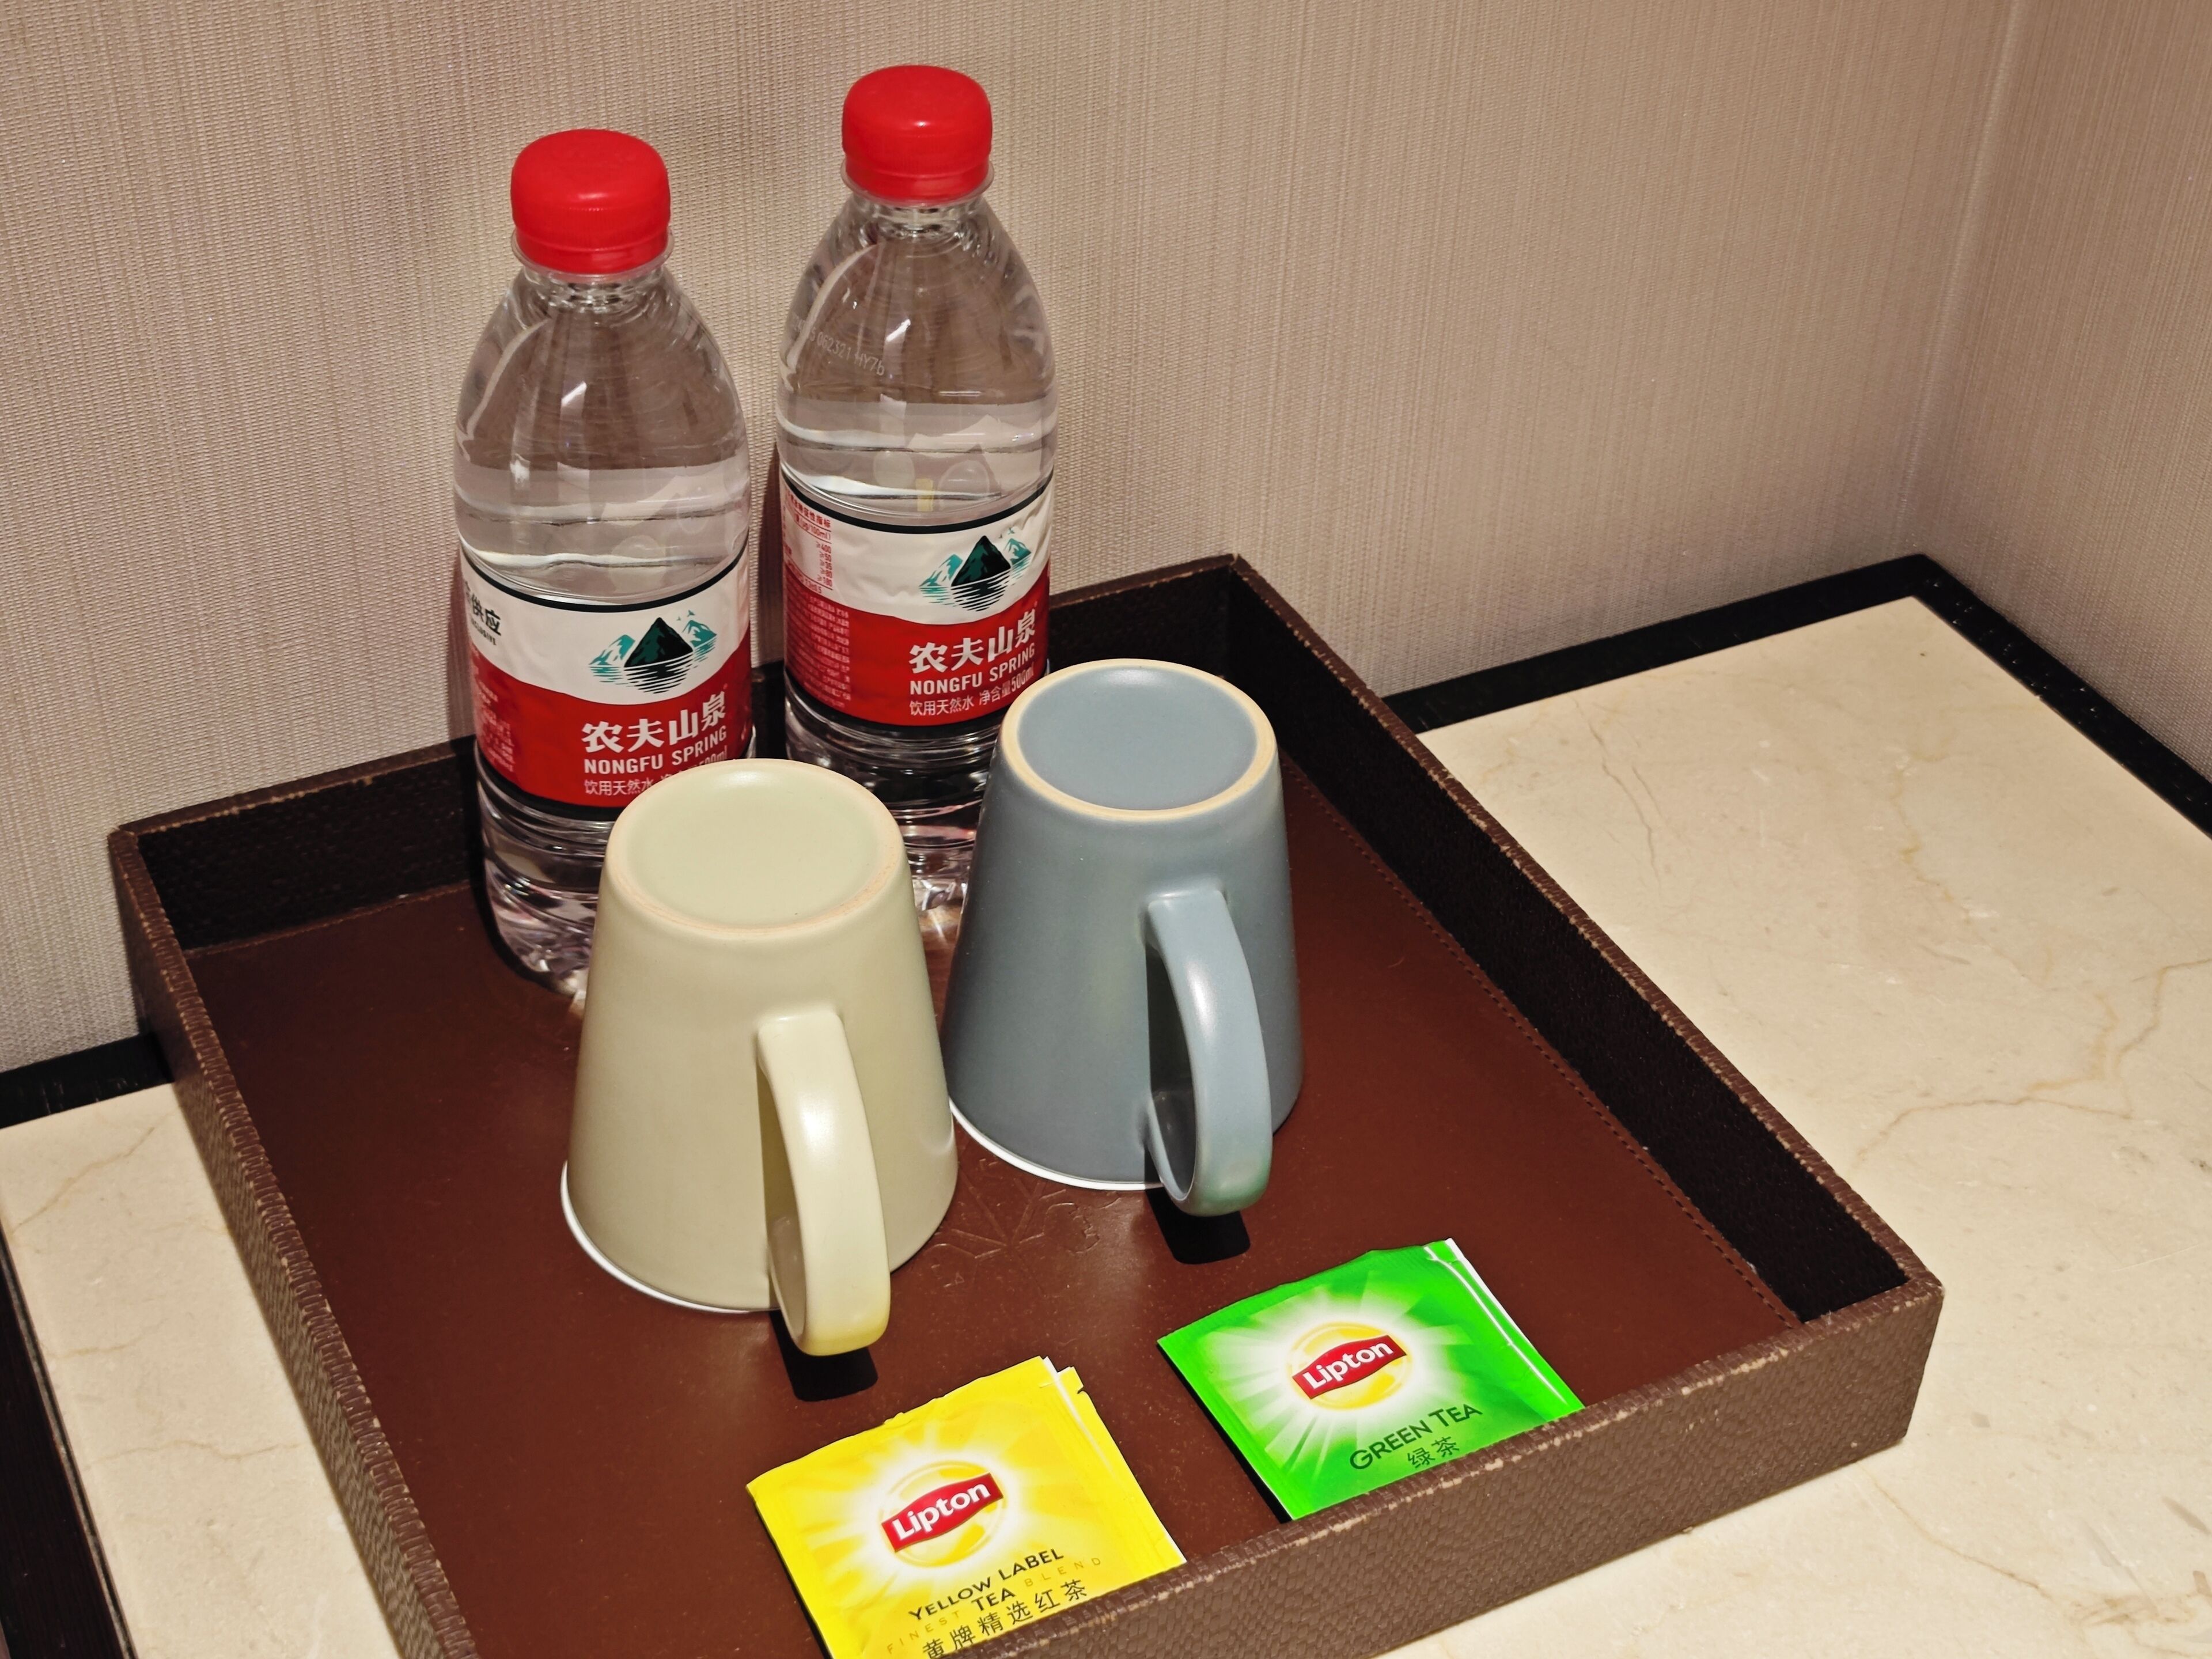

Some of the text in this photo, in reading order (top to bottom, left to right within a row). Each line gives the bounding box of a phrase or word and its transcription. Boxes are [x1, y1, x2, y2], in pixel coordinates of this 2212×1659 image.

[908, 608, 1036, 674] 农夫山泉
[910, 642, 1035, 695] NONGFU SPRING
[581, 691, 727, 753] 农夫山泉
[909, 695, 975, 717] 饮用天然水
[584, 725, 727, 775] NONGFU SPRING
[584, 778, 654, 796] 饮用天然水
[1302, 1341, 1394, 1389] Lipton
[1349, 1403, 1483, 1470] GREEN TEA
[1407, 1435, 1460, 1469] 绿茶
[891, 1482, 991, 1541] Lipton
[887, 1557, 1101, 1654] FINEST BLEND
[908, 1548, 1065, 1622] YELLOW LABEL
[971, 1587, 1016, 1612] TEA
[922, 1579, 1088, 1659] 黄牌精选红茶
